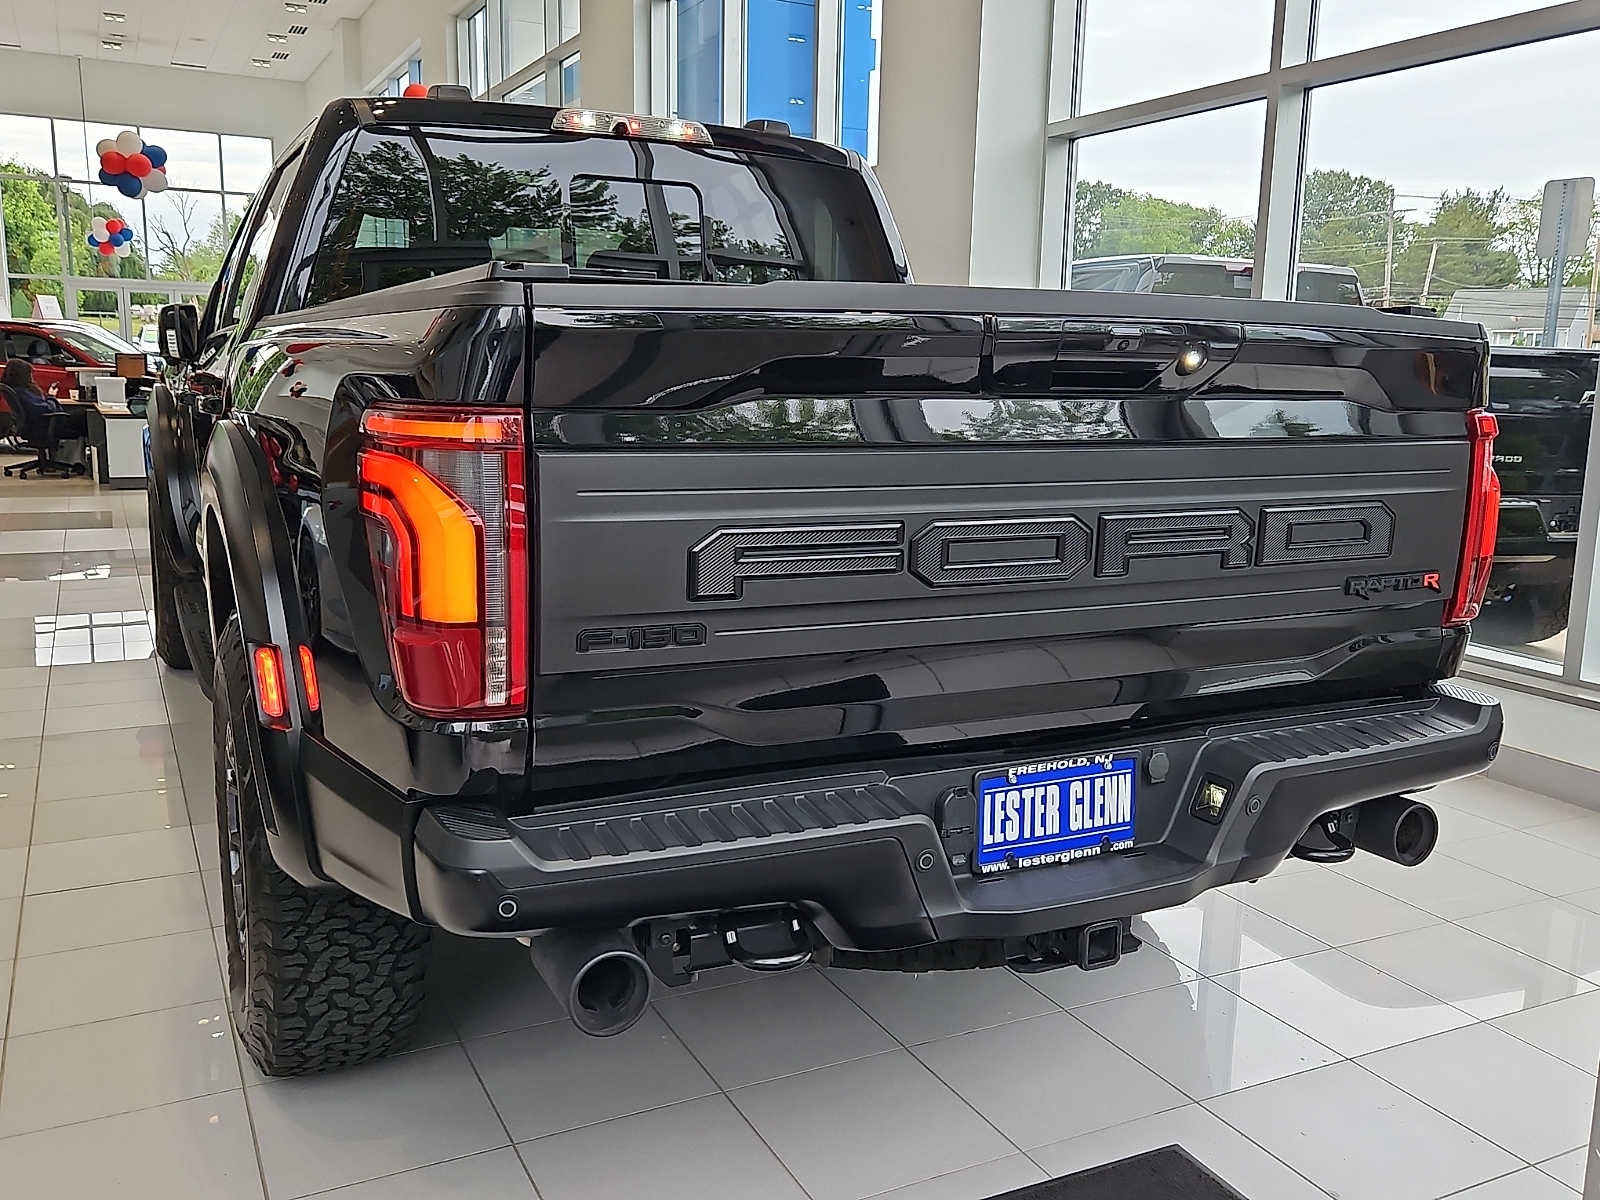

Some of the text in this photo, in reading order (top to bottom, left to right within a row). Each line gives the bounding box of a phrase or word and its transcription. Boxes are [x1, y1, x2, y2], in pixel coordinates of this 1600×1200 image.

[687, 502, 1395, 601] FORD
[1344, 570, 1441, 600] RAPTOR
[576, 622, 707, 653] F-150
[1008, 753, 1114, 777] FREEHOLD, NJ
[983, 774, 1132, 846] LESTER GLENN
[981, 839, 1134, 874] www. lesterglenn .com
